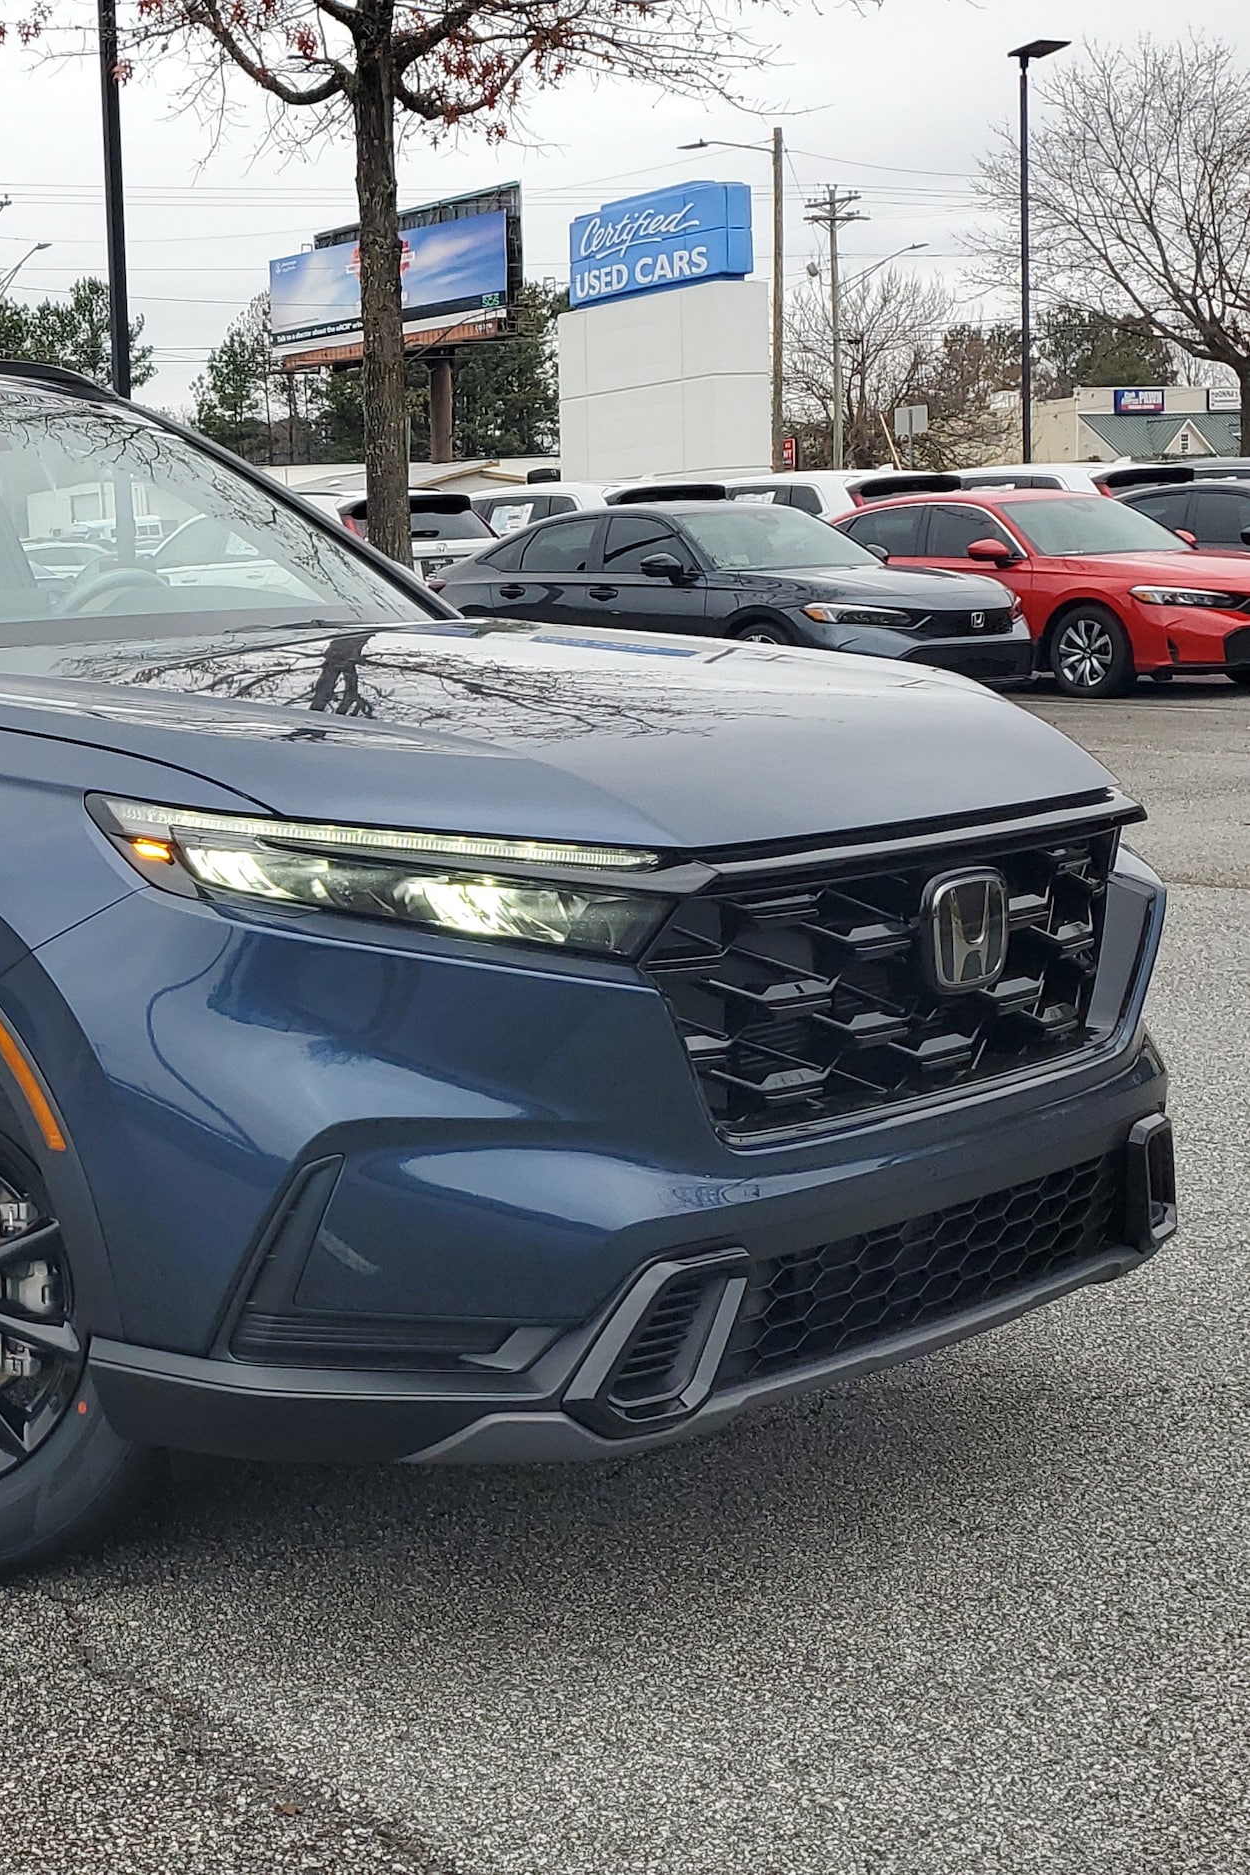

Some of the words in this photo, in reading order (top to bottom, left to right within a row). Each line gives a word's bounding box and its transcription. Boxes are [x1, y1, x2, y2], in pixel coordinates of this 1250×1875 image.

[580, 203, 700, 259] Certified
[575, 263, 629, 299] USED
[635, 246, 708, 284] CARS
